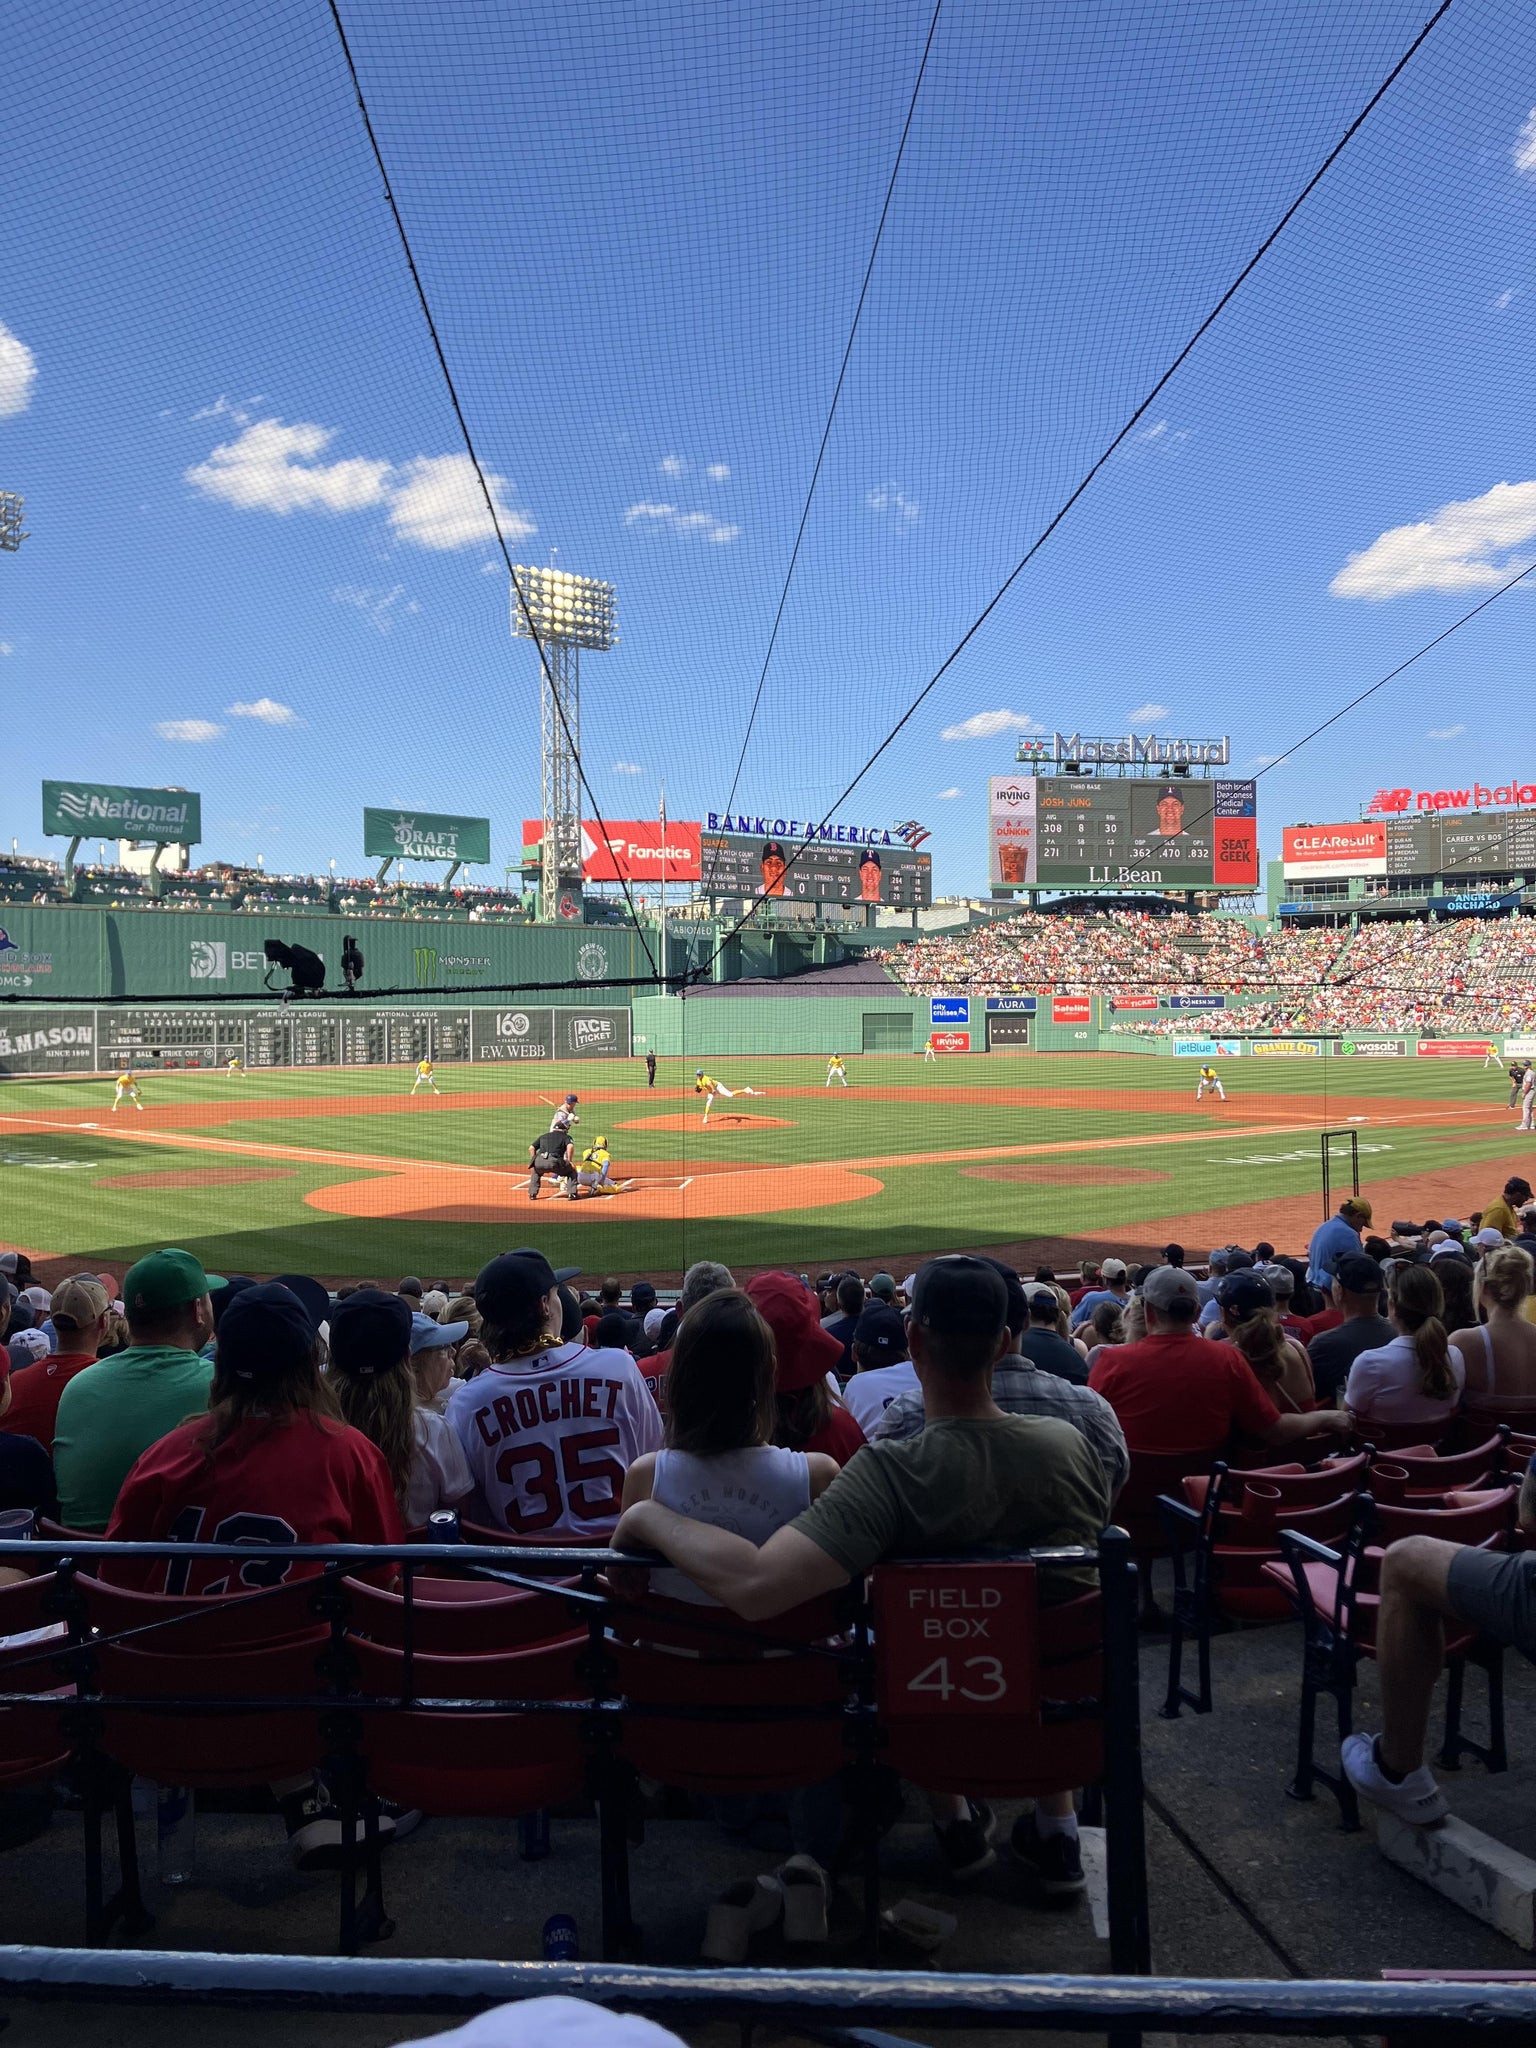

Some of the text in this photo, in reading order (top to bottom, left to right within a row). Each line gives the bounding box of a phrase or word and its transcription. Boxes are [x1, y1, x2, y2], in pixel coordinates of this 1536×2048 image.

[1054, 732, 1230, 764] MassMutual
[997, 792, 1030, 800] IRVING
[1416, 790, 1471, 810] new
[1040, 798, 1092, 807] JOSH JUNG
[89, 796, 188, 822] National
[1217, 807, 1240, 815] Center
[124, 821, 184, 834] Car Rental
[707, 812, 891, 845] BANK OF AMERICA
[1040, 824, 1062, 833] .308
[1078, 824, 1084, 833] 8
[1105, 824, 1117, 833] 30
[394, 828, 459, 845] DRAFT
[1293, 834, 1376, 850] CLEAResult
[1446, 835, 1474, 843] CAREER
[1222, 839, 1250, 850] SEAT
[402, 844, 458, 858] KINGS
[628, 844, 691, 859] Fanatics
[1044, 848, 1059, 857] 271
[1129, 849, 1151, 858] .362
[1159, 849, 1180, 857] .470
[1188, 849, 1209, 858] .832
[1220, 851, 1251, 862] GEEK
[814, 874, 834, 882] STRIKES
[1089, 866, 1162, 882] L.L.Bean
[799, 882, 805, 894] 0
[821, 884, 825, 895] 1
[841, 885, 847, 896] 2
[1455, 893, 1492, 902] ANGRY
[1447, 901, 1500, 911] ORCHARD
[578, 943, 607, 956] IBEW 103
[439, 956, 491, 966] MONSTER
[933, 1003, 946, 1011] city
[1054, 1004, 1089, 1012] Safelite
[1130, 998, 1157, 1008] TICKET
[496, 1012, 530, 1036] 160
[578, 1019, 612, 1035] ACE
[578, 1032, 612, 1044] TICKET
[1074, 1031, 1088, 1039] 420
[1178, 1042, 1212, 1053] jetBlue
[1253, 1041, 1318, 1055] GRANITE CITY
[1356, 1040, 1399, 1051] wasabi
[480, 1045, 546, 1058] F.W. WEBB
[475, 1378, 623, 1447] CROCHET
[496, 1427, 625, 1534] 35
[680, 1486, 782, 1524] EEN MONST
[908, 1588, 1002, 1609] FIELD
[923, 1617, 991, 1639] BOX
[906, 1655, 1007, 1702] 43
